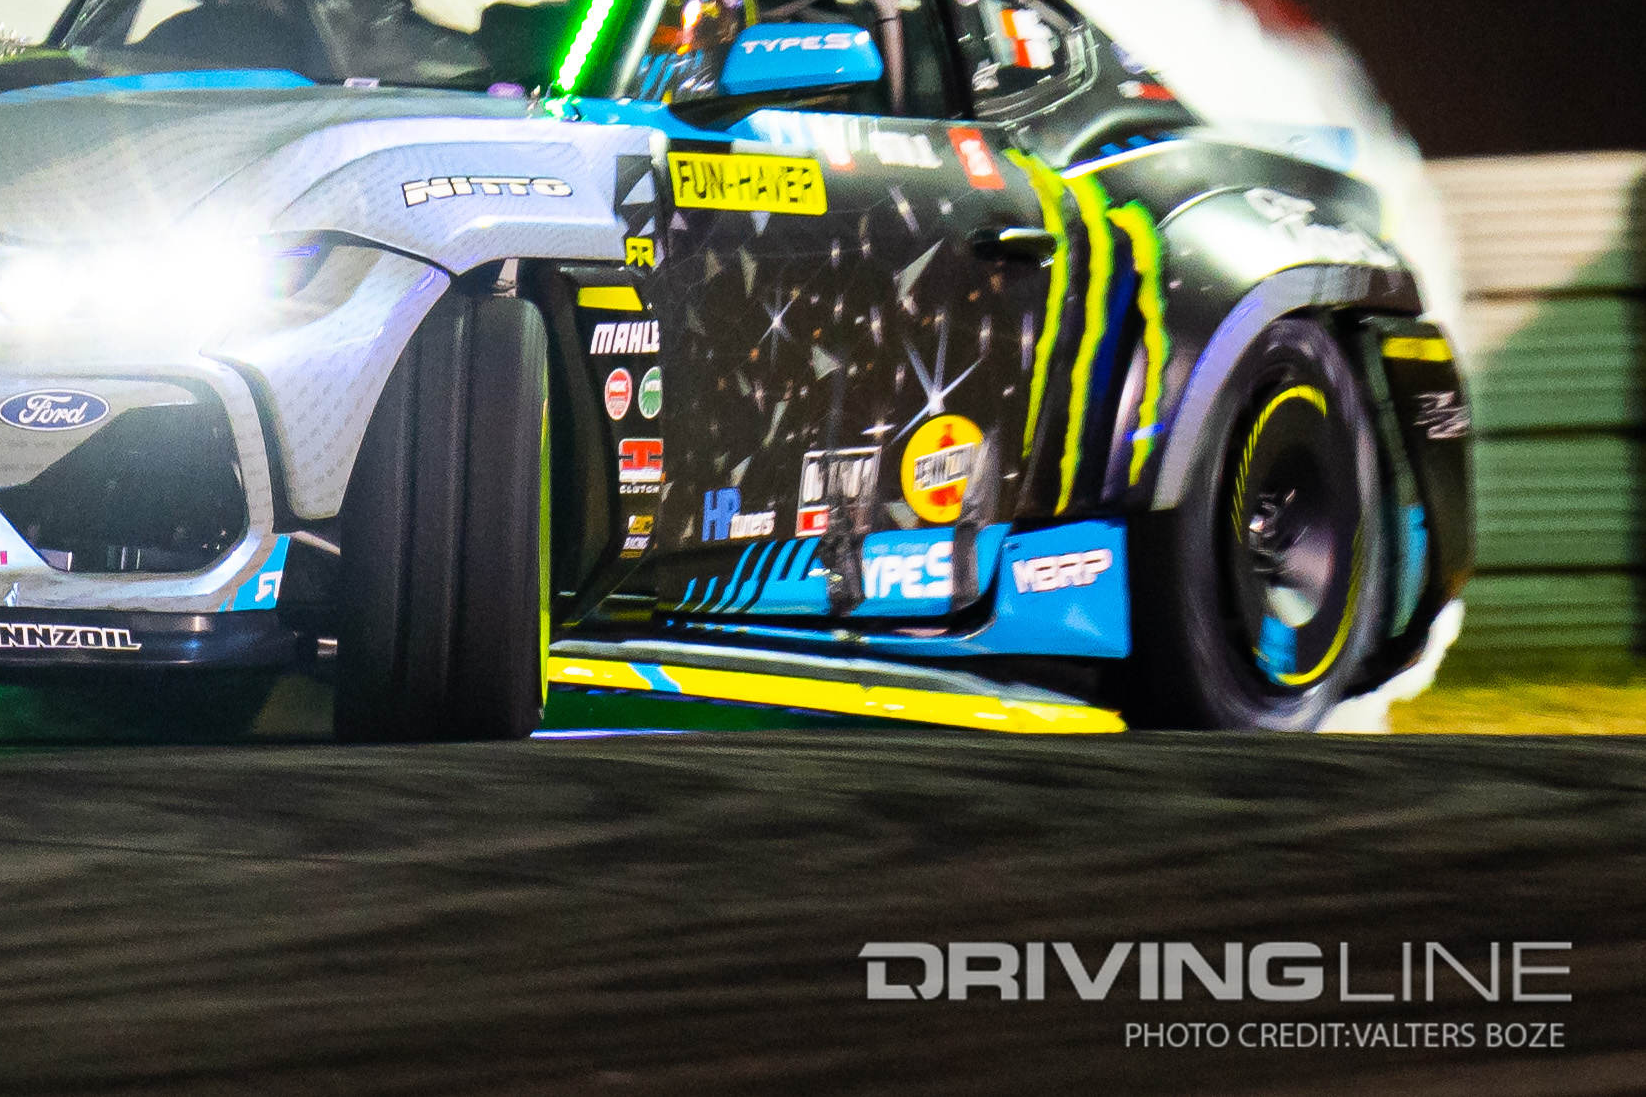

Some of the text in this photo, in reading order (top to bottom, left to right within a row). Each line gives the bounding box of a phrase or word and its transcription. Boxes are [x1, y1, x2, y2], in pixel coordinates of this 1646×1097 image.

[403, 177, 574, 207] NITTO
[18, 394, 89, 424] Ford
[1012, 549, 1113, 595] MBRP
